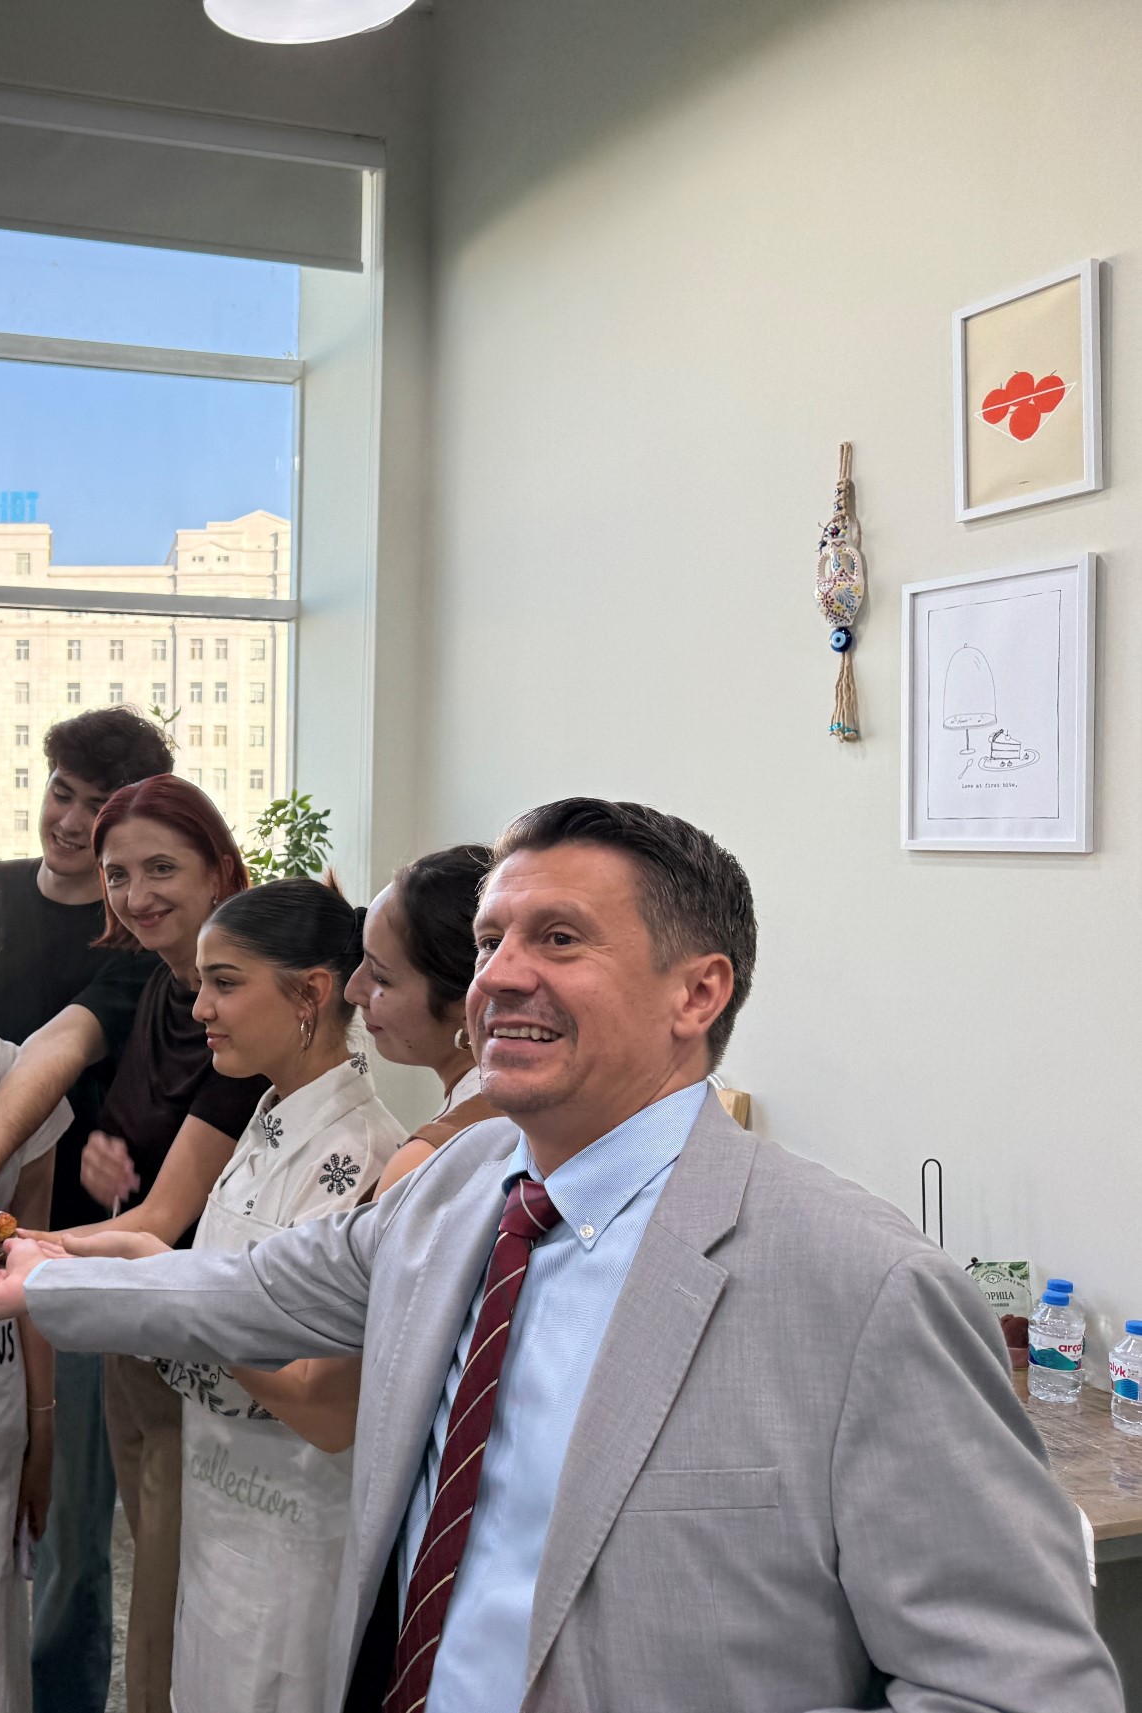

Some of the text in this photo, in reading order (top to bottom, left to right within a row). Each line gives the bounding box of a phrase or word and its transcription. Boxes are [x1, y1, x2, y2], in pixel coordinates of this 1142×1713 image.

[985, 1291, 1015, 1300] ОРИЦА
[1058, 1343, 1082, 1355] arça
[1109, 1361, 1126, 1378] alyk
[191, 1442, 303, 1524] collection
